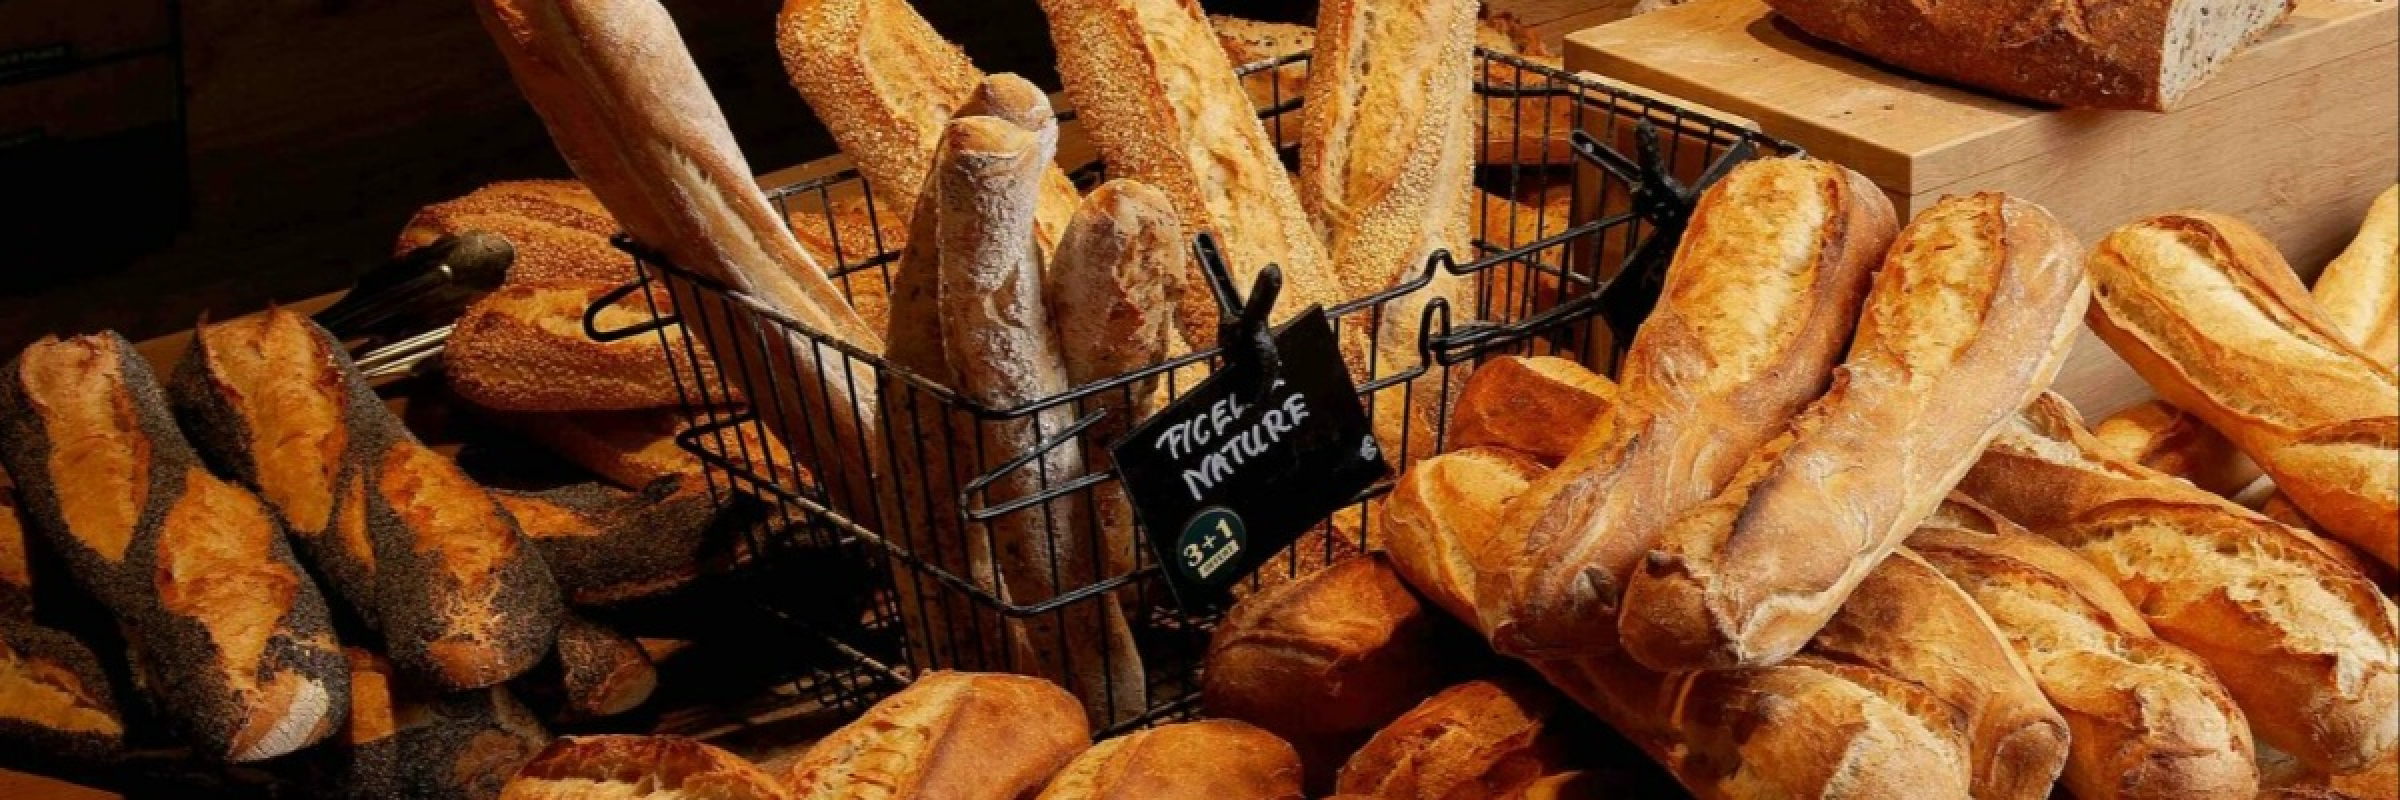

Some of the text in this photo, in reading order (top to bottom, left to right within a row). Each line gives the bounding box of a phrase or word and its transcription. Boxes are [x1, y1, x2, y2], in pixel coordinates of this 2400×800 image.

[1155, 379, 1286, 459] FICEL
[1182, 393, 1310, 500] NATURE
[1184, 518, 1233, 567] 3+1
